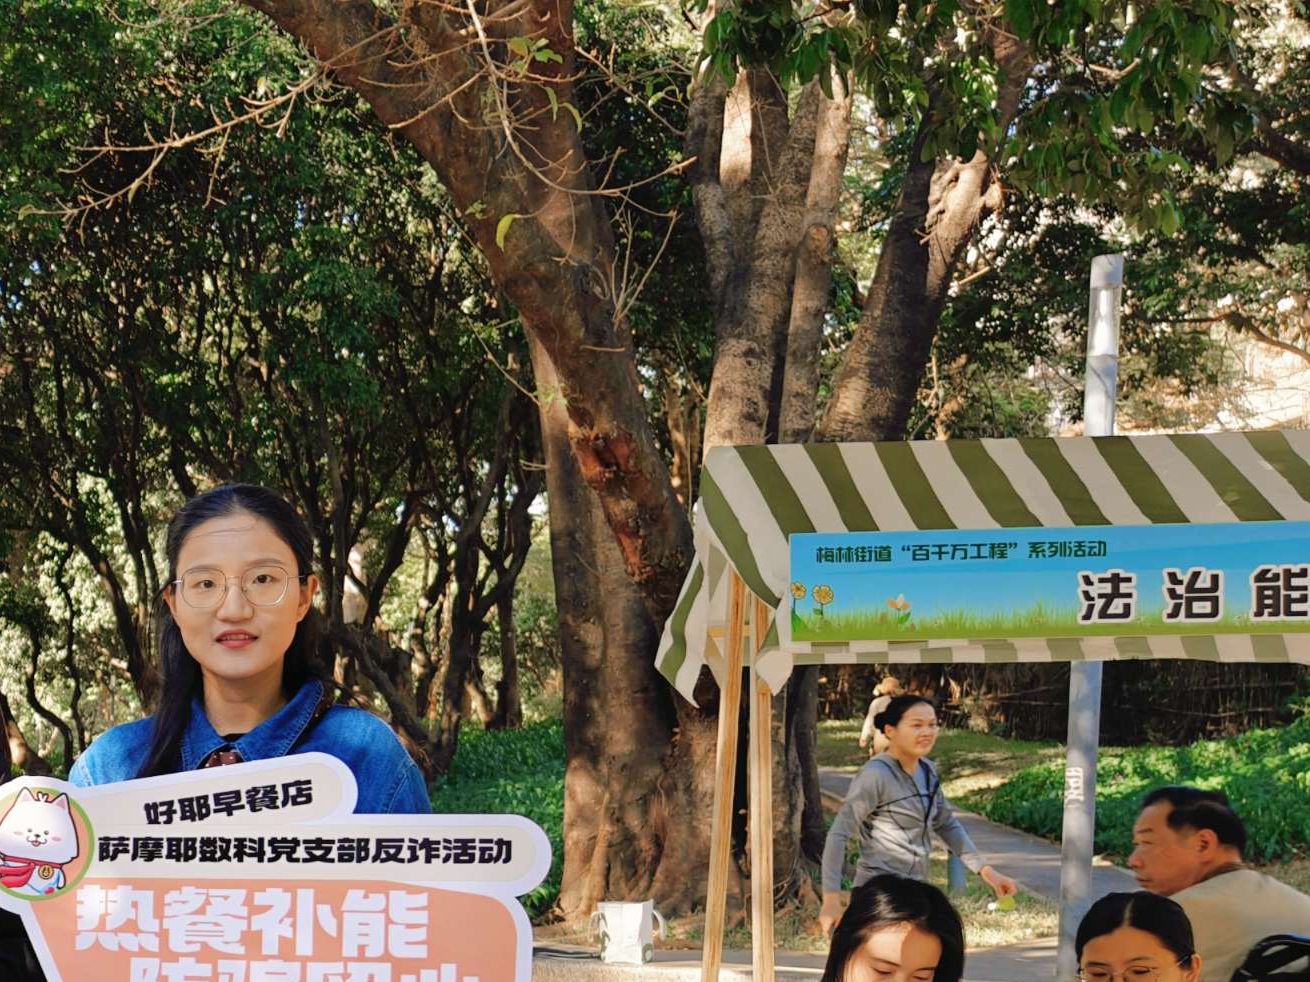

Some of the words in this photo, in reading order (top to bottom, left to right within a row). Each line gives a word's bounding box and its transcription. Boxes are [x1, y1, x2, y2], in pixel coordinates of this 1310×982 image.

[1080, 567, 1309, 620] 法治能
[144, 780, 313, 825] 好耶早餐店
[97, 836, 513, 866] 萨摩耶数科党支部反诈活动
[74, 889, 430, 959] 热餐补能
